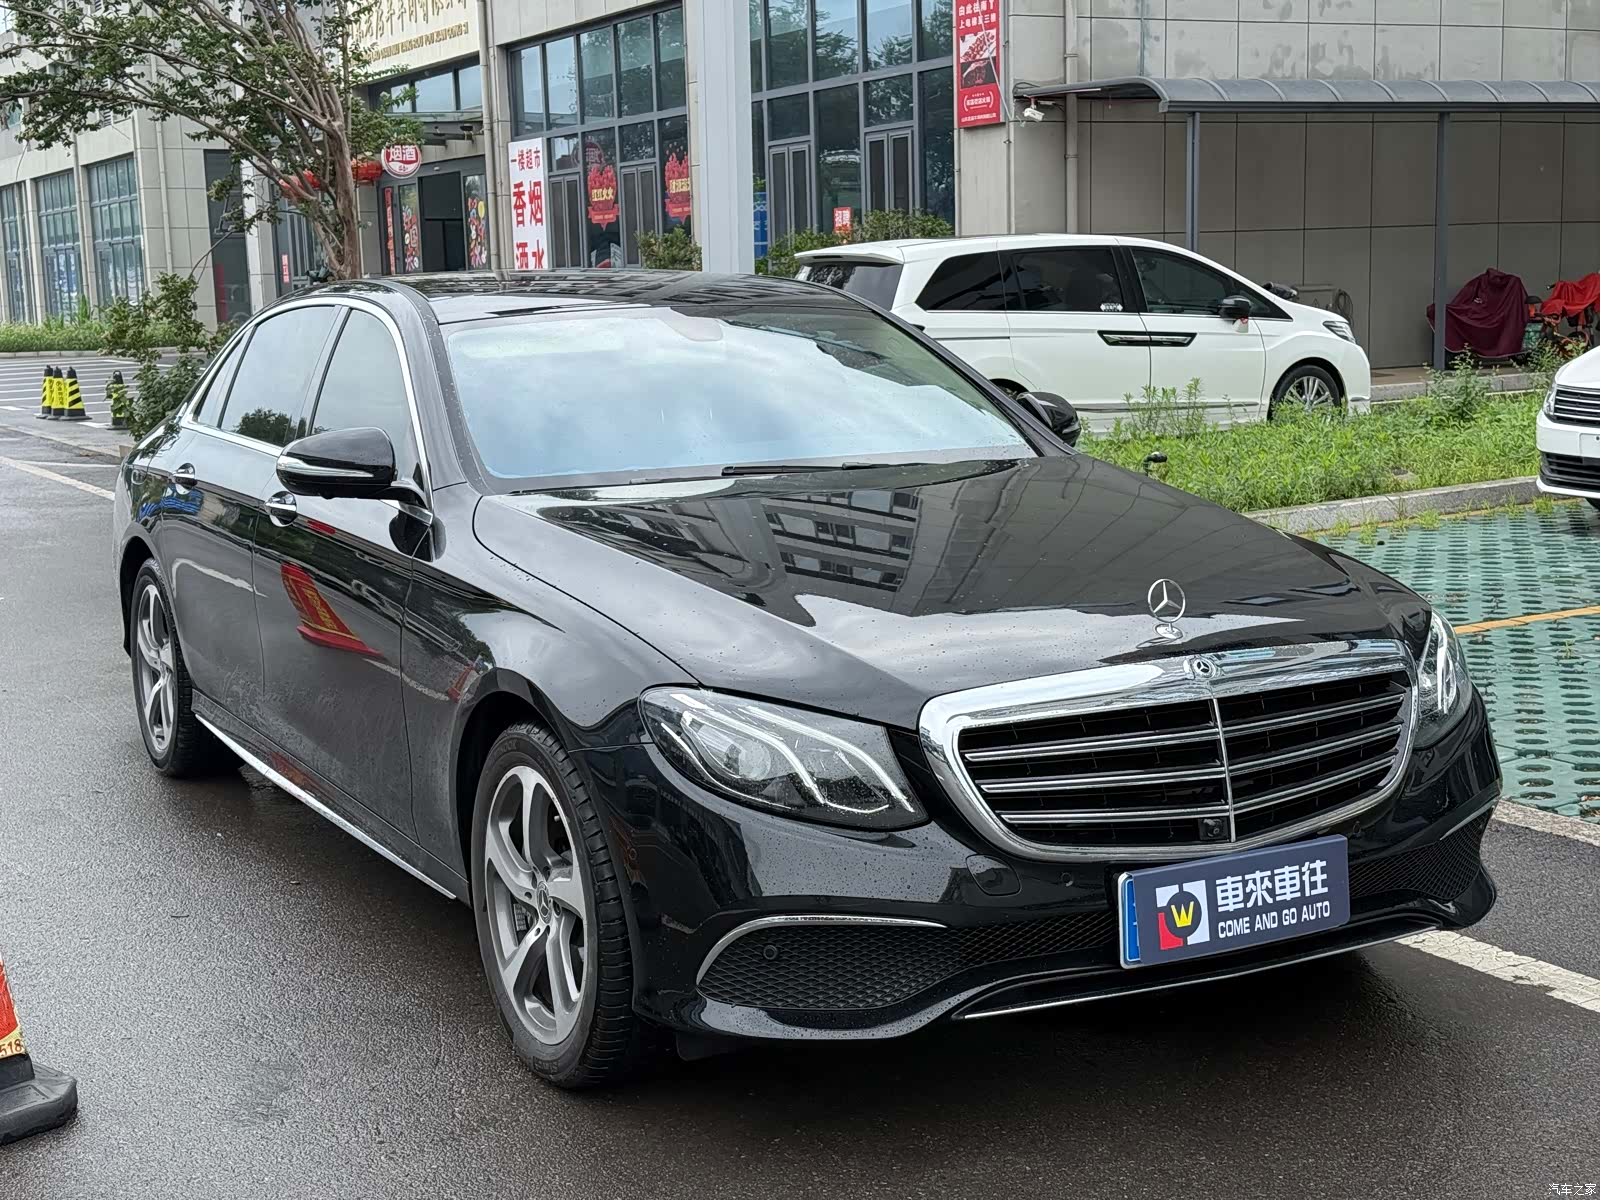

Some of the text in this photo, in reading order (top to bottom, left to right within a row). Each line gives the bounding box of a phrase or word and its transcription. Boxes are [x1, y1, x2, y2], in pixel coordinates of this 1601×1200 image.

[389, 144, 416, 161] 烟酒
[511, 147, 541, 171] 一楼超市
[512, 180, 543, 227] 香烟
[1215, 860, 1328, 912] 車來車往
[1218, 901, 1331, 938] COME AND GO AUTO
